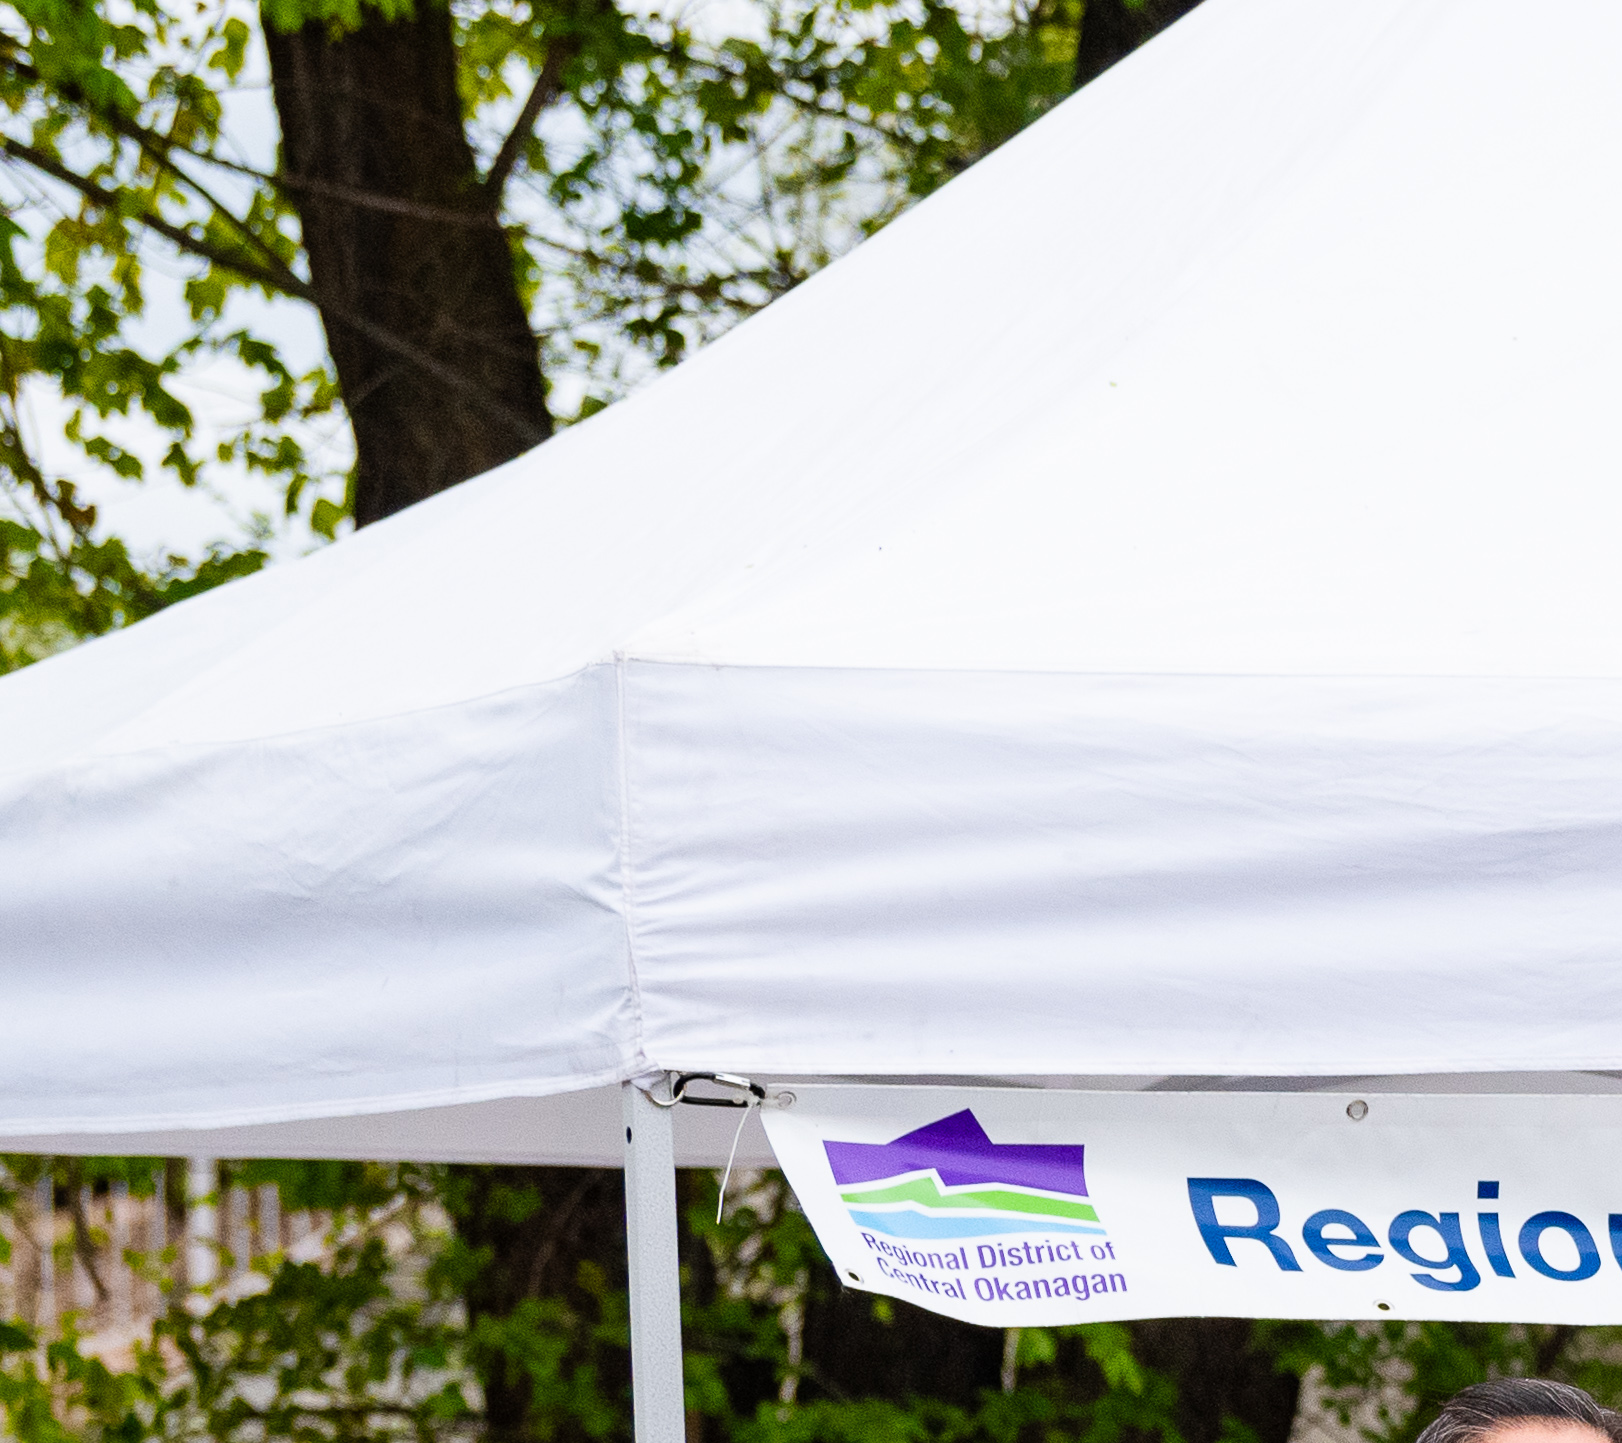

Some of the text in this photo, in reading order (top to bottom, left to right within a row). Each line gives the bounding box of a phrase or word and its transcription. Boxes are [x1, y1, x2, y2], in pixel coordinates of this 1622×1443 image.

[861, 1232, 1116, 1270] Regional District of
[876, 1257, 1128, 1301] Central Okanagan
